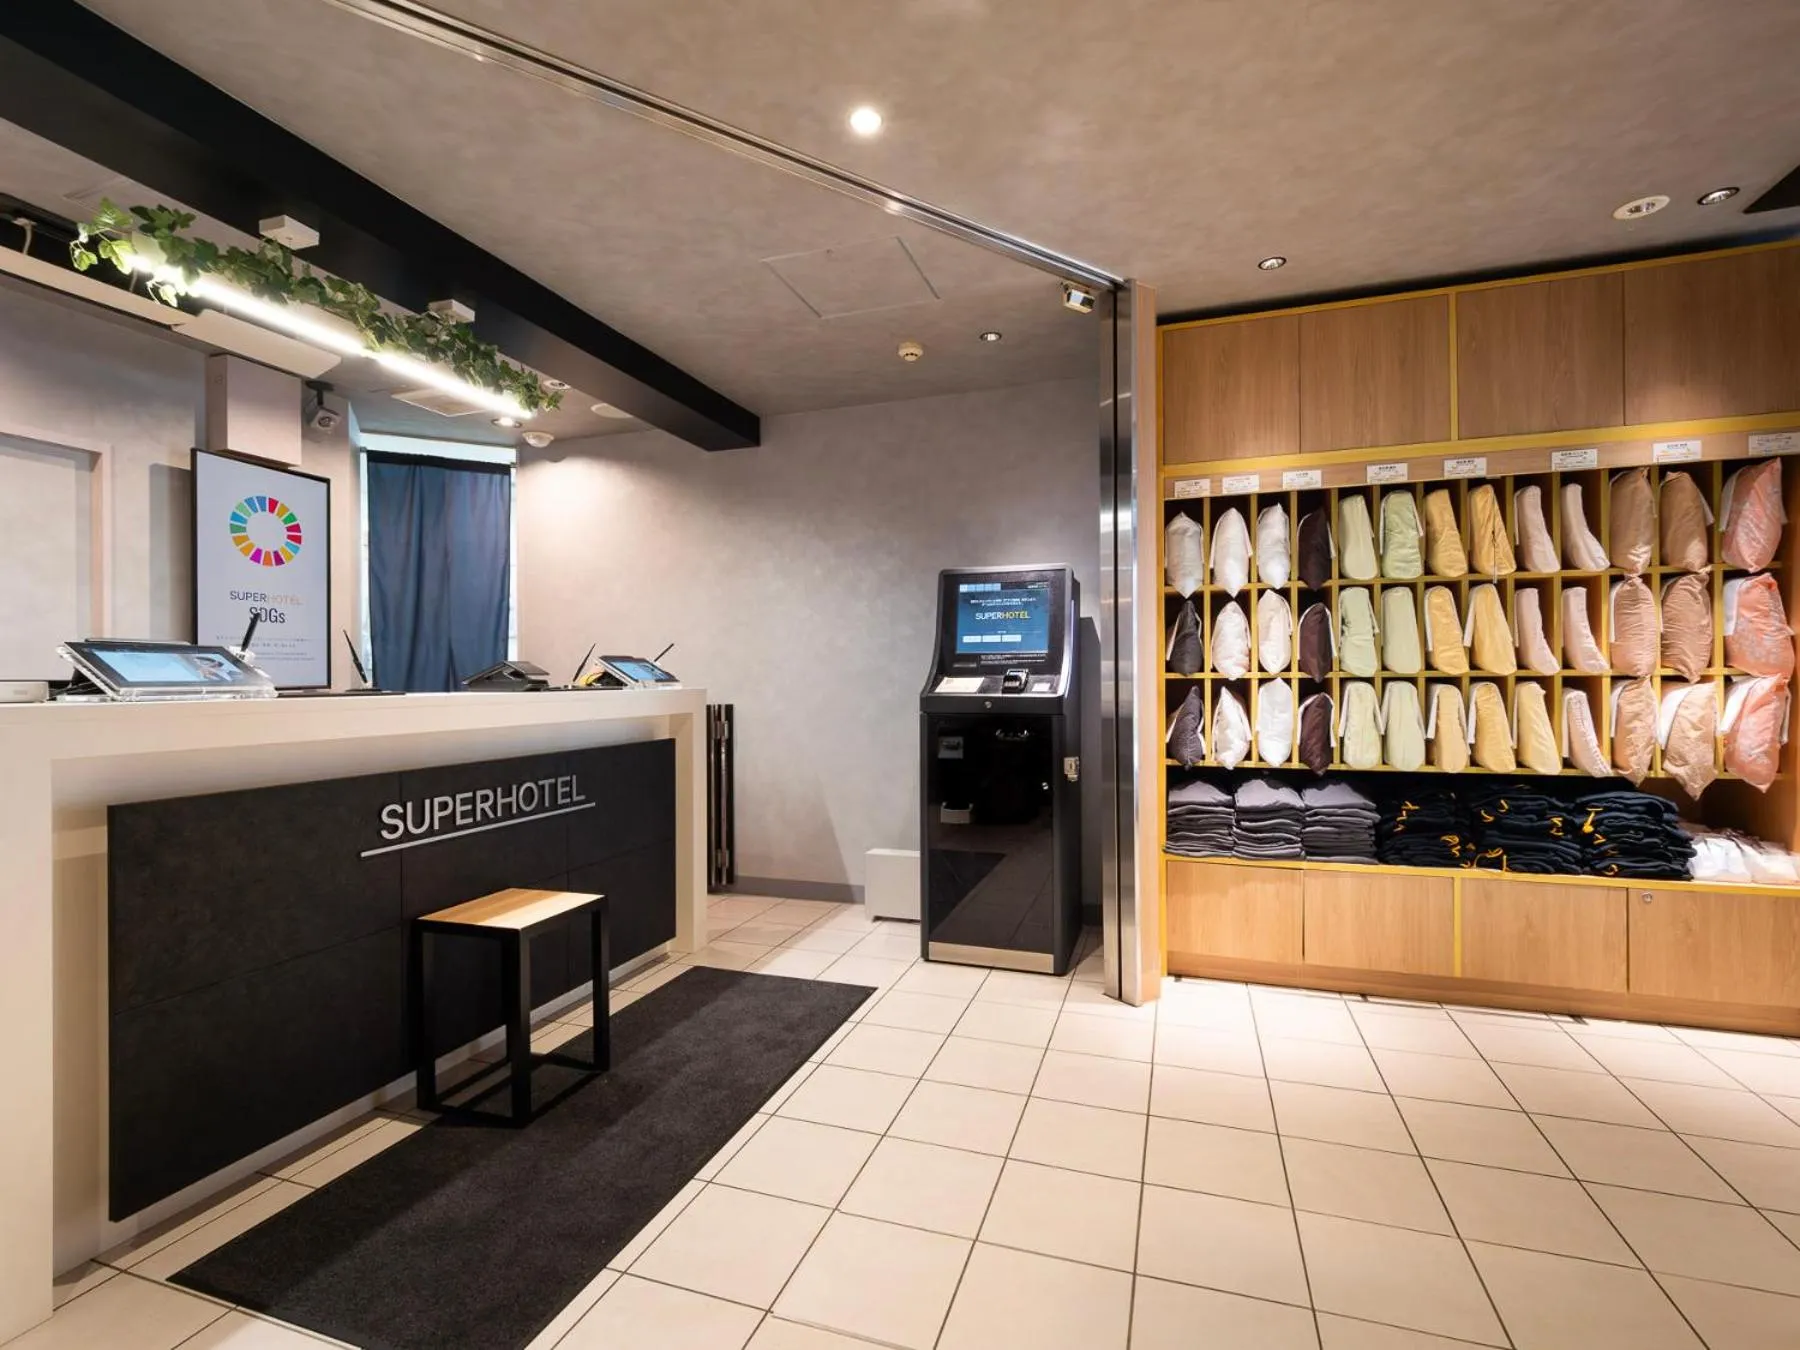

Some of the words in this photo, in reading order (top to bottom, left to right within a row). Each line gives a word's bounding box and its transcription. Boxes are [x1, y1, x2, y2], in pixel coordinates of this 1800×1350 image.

[230, 590, 303, 606] SUPERHOTEL
[975, 611, 1030, 620] SUPERHOTEL
[380, 774, 586, 840] SUPERHOTEL
